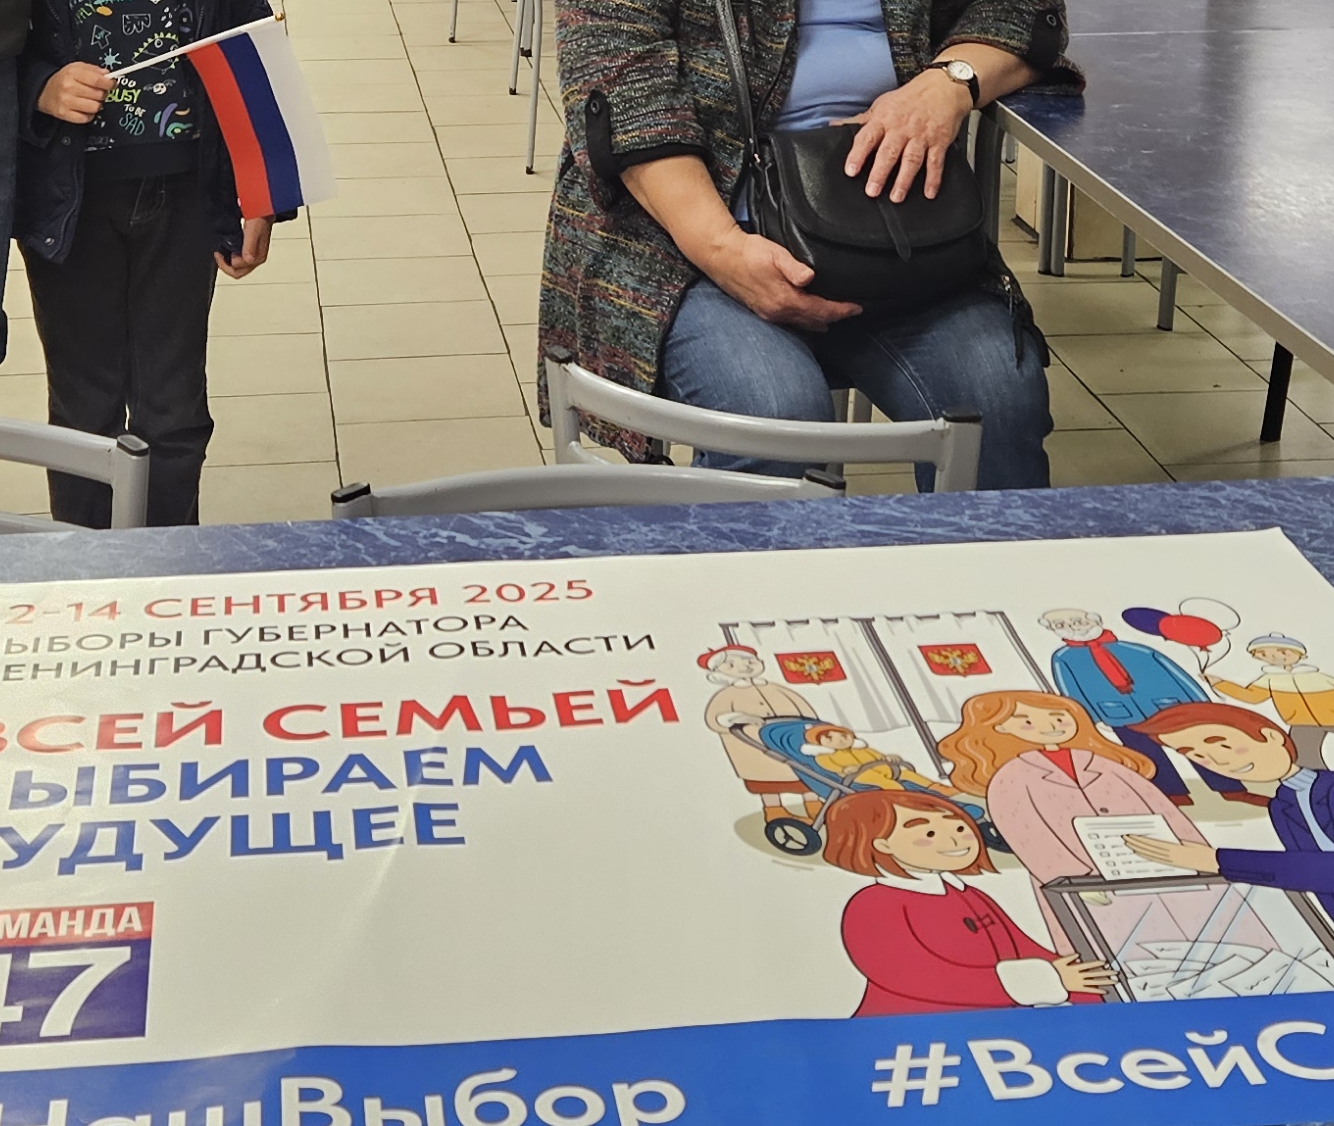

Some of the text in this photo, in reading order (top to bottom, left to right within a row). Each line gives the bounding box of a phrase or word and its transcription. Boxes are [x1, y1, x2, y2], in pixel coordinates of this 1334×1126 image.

[105, 88, 142, 104] BUSY
[119, 112, 146, 136] SAD
[143, 586, 439, 619] СЕНТЯБРЯ
[463, 579, 594, 604] 2025
[202, 614, 530, 646] ГУБЕРНАТОРА
[428, 633, 656, 660] ОБЛАСТИ
[262, 678, 680, 741] СЕМЬЕЙ
